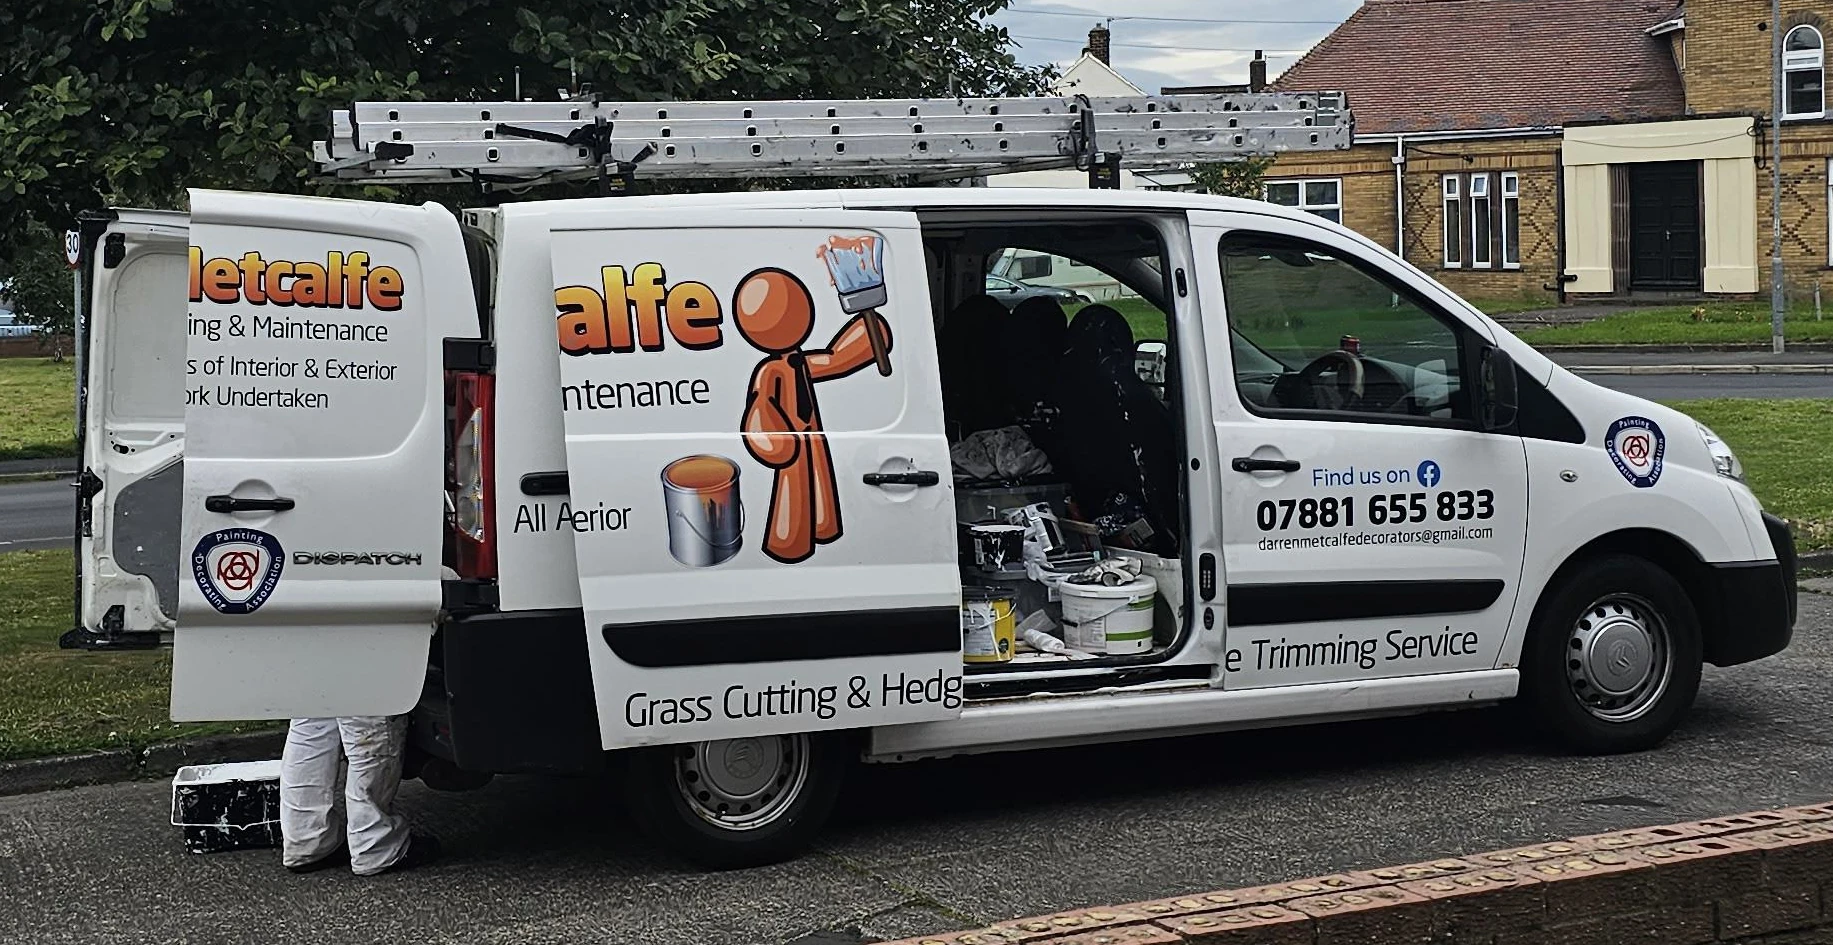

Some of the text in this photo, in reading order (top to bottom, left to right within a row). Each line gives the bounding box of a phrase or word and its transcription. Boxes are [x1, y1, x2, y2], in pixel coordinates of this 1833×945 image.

[66, 233, 79, 254] 30
[554, 262, 723, 356] alfe
[188, 312, 388, 342] ing & Maintenance
[187, 355, 398, 381] s of Interior & Exterior
[216, 385, 329, 409] Undertaken
[561, 379, 710, 412] ntenance
[1618, 418, 1650, 429] Painting
[1606, 440, 1637, 485] Decorating
[1648, 438, 1664, 484] Association
[1312, 466, 1354, 487] Find
[1360, 470, 1382, 485] us
[1386, 469, 1411, 484] on
[513, 503, 546, 533] All
[1256, 489, 1495, 532] 07881 655 833
[215, 531, 264, 545] Painting
[1258, 525, 1494, 551] darrenmetcalfedecorators@gmail.com
[292, 551, 422, 566] DISPATCH
[195, 554, 227, 611] Decorating
[245, 556, 282, 611] Association
[1225, 626, 1478, 673] e Trimming Service
[625, 668, 963, 728] Grass Cutting & Hedg
